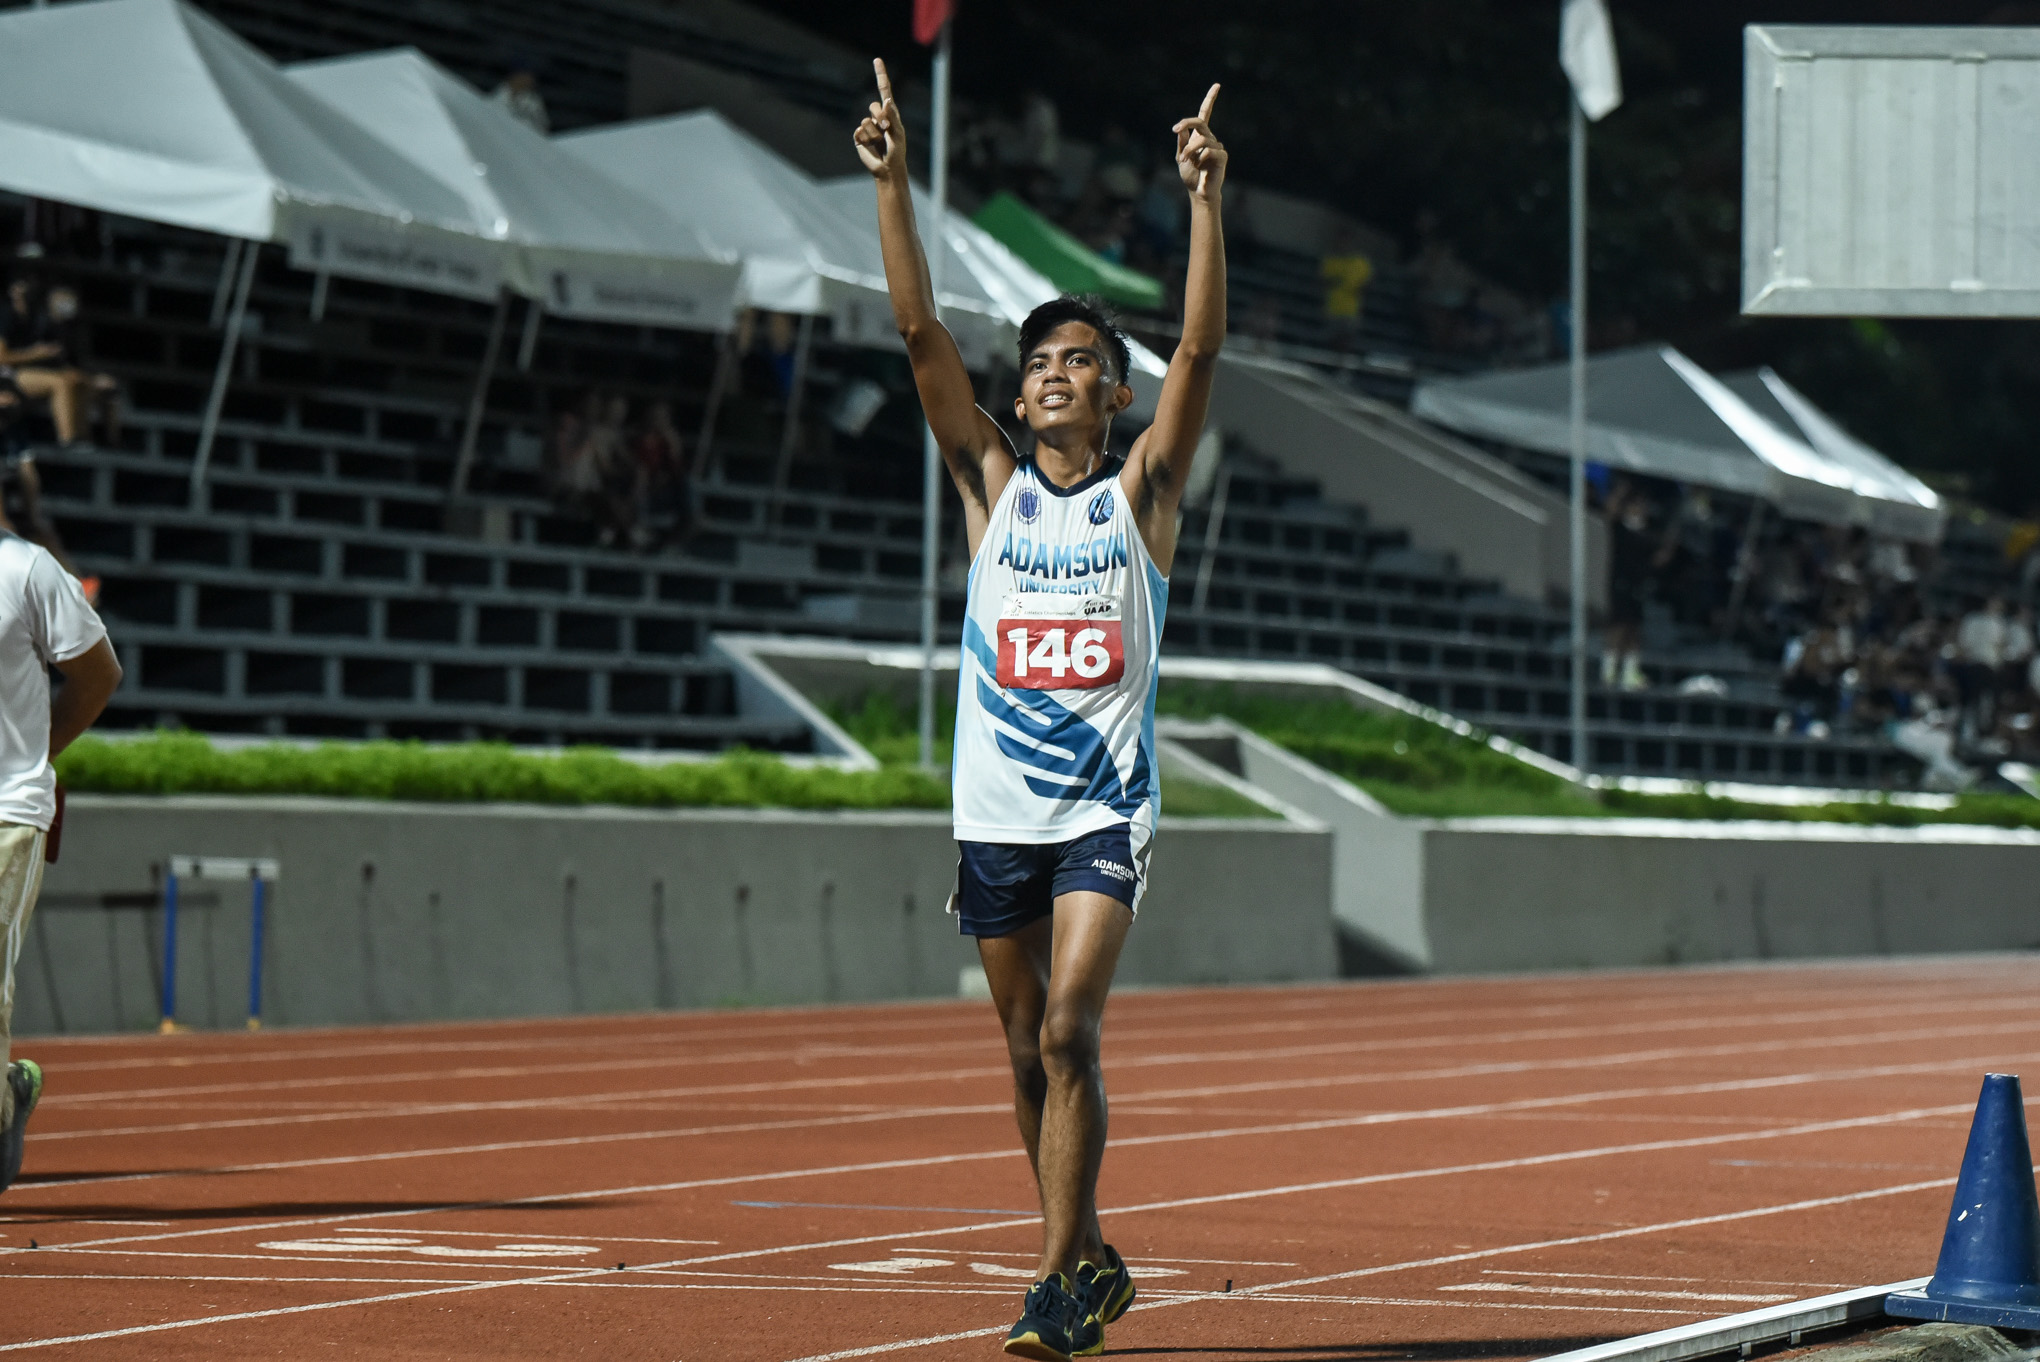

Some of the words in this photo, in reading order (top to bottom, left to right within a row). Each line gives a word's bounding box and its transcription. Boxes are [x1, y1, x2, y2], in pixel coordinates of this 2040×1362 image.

[998, 532, 1127, 580] ADAMSON
[1084, 605, 1112, 615] UAAP
[1007, 627, 1110, 679] 146
[1091, 859, 1135, 881] ADAMSON
[1100, 869, 1127, 882] UNIVERSITY
